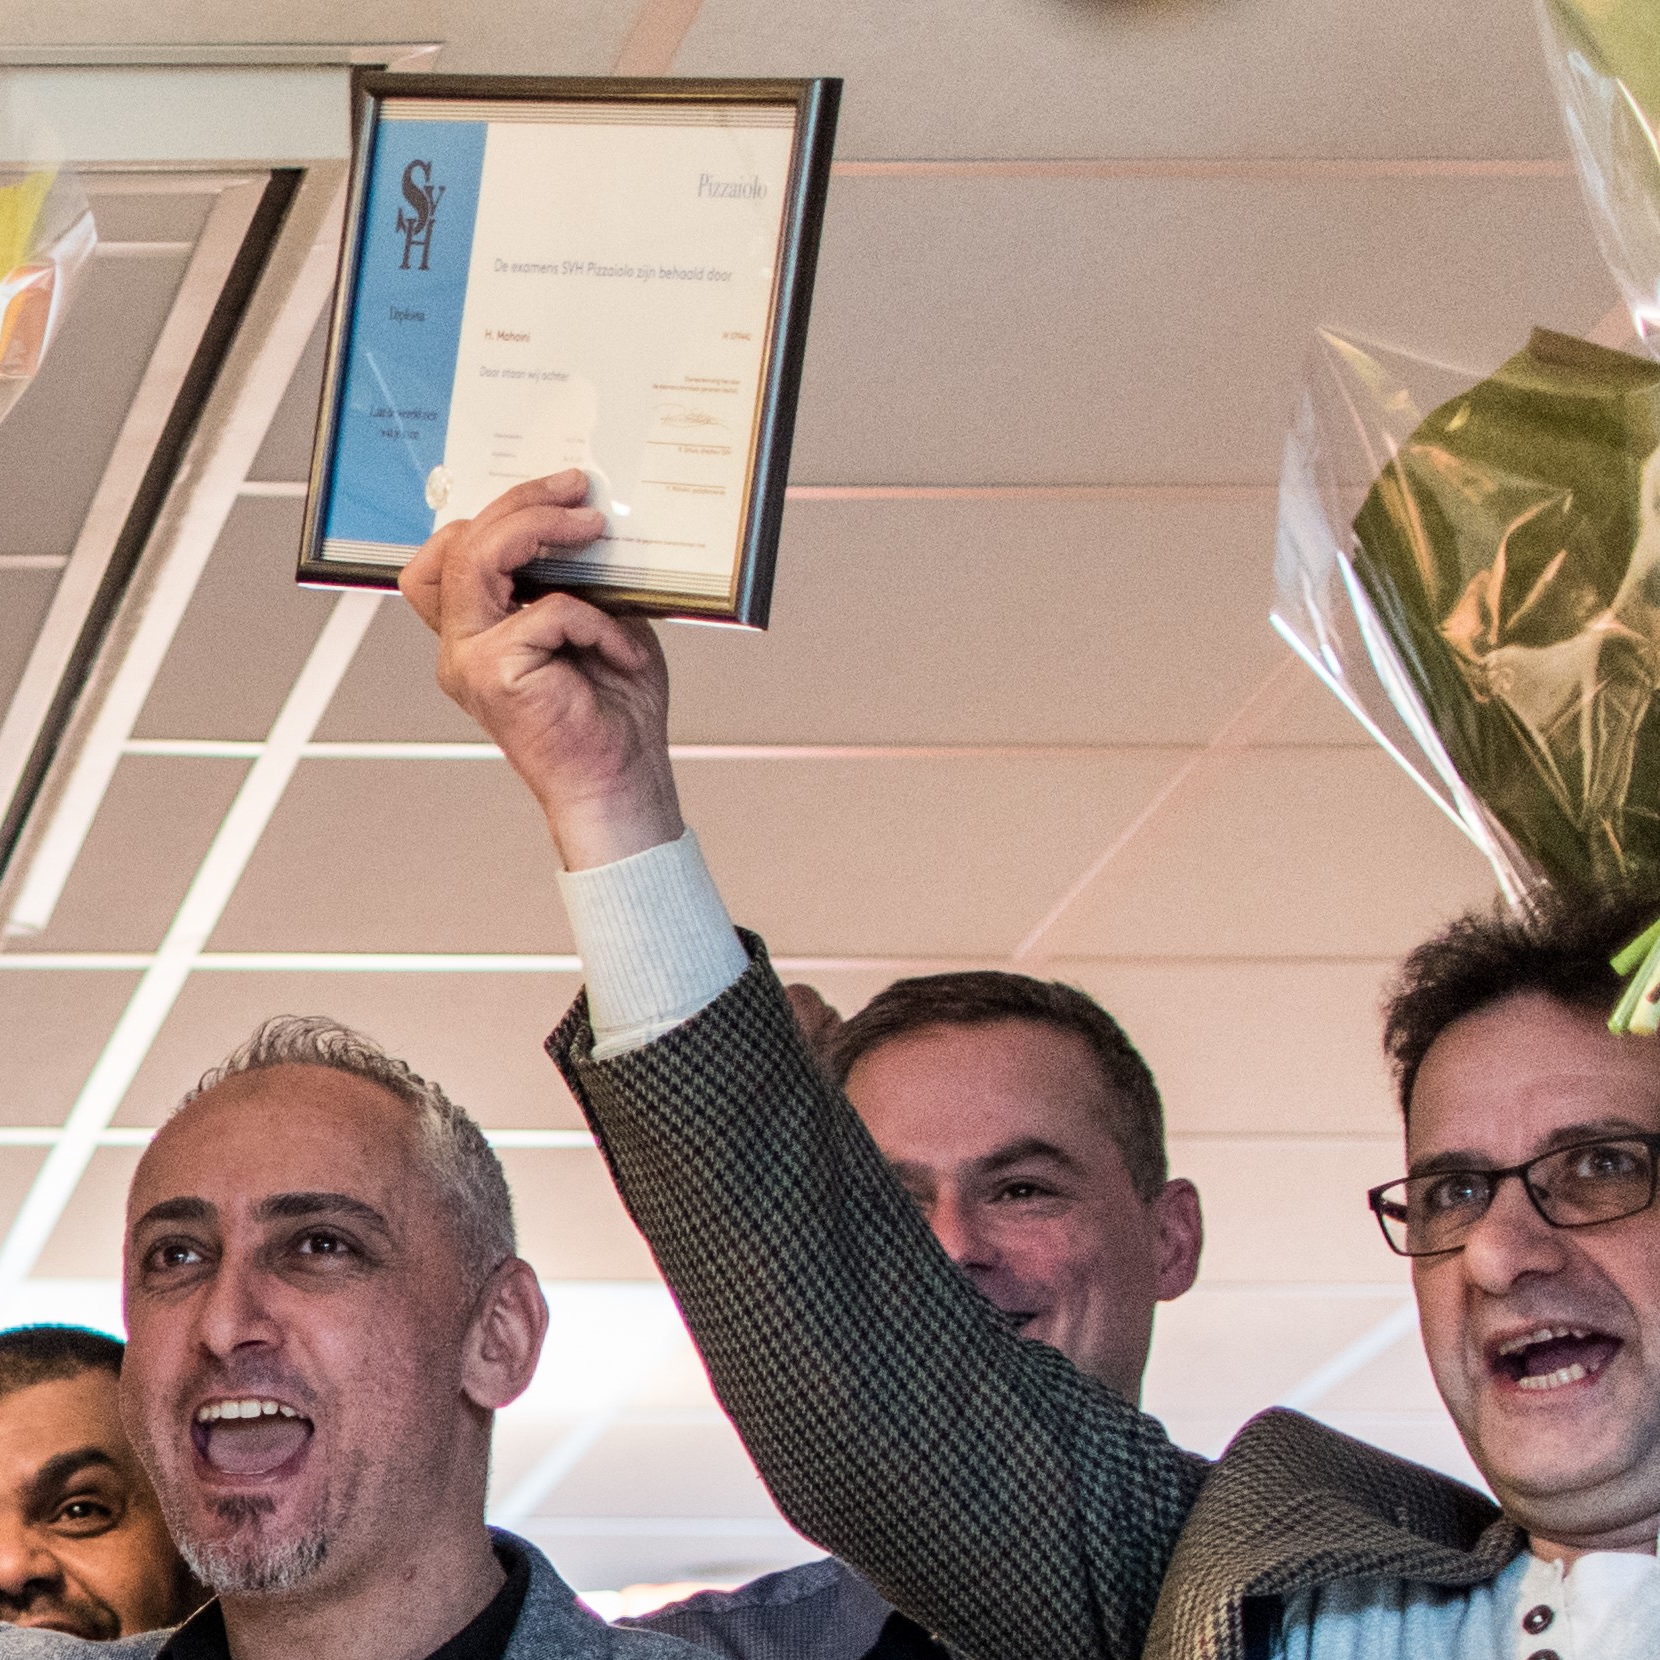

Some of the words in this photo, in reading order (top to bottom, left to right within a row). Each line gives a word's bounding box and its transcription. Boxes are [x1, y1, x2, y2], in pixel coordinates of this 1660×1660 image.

[698, 173, 768, 199] Pizzaiolo
[494, 258, 509, 273] De
[511, 262, 559, 275] examens
[561, 261, 585, 275] SVH
[587, 261, 634, 278] Pizzaiolo
[636, 264, 656, 283] zijn
[659, 266, 704, 281] behaald
[706, 269, 733, 282] door
